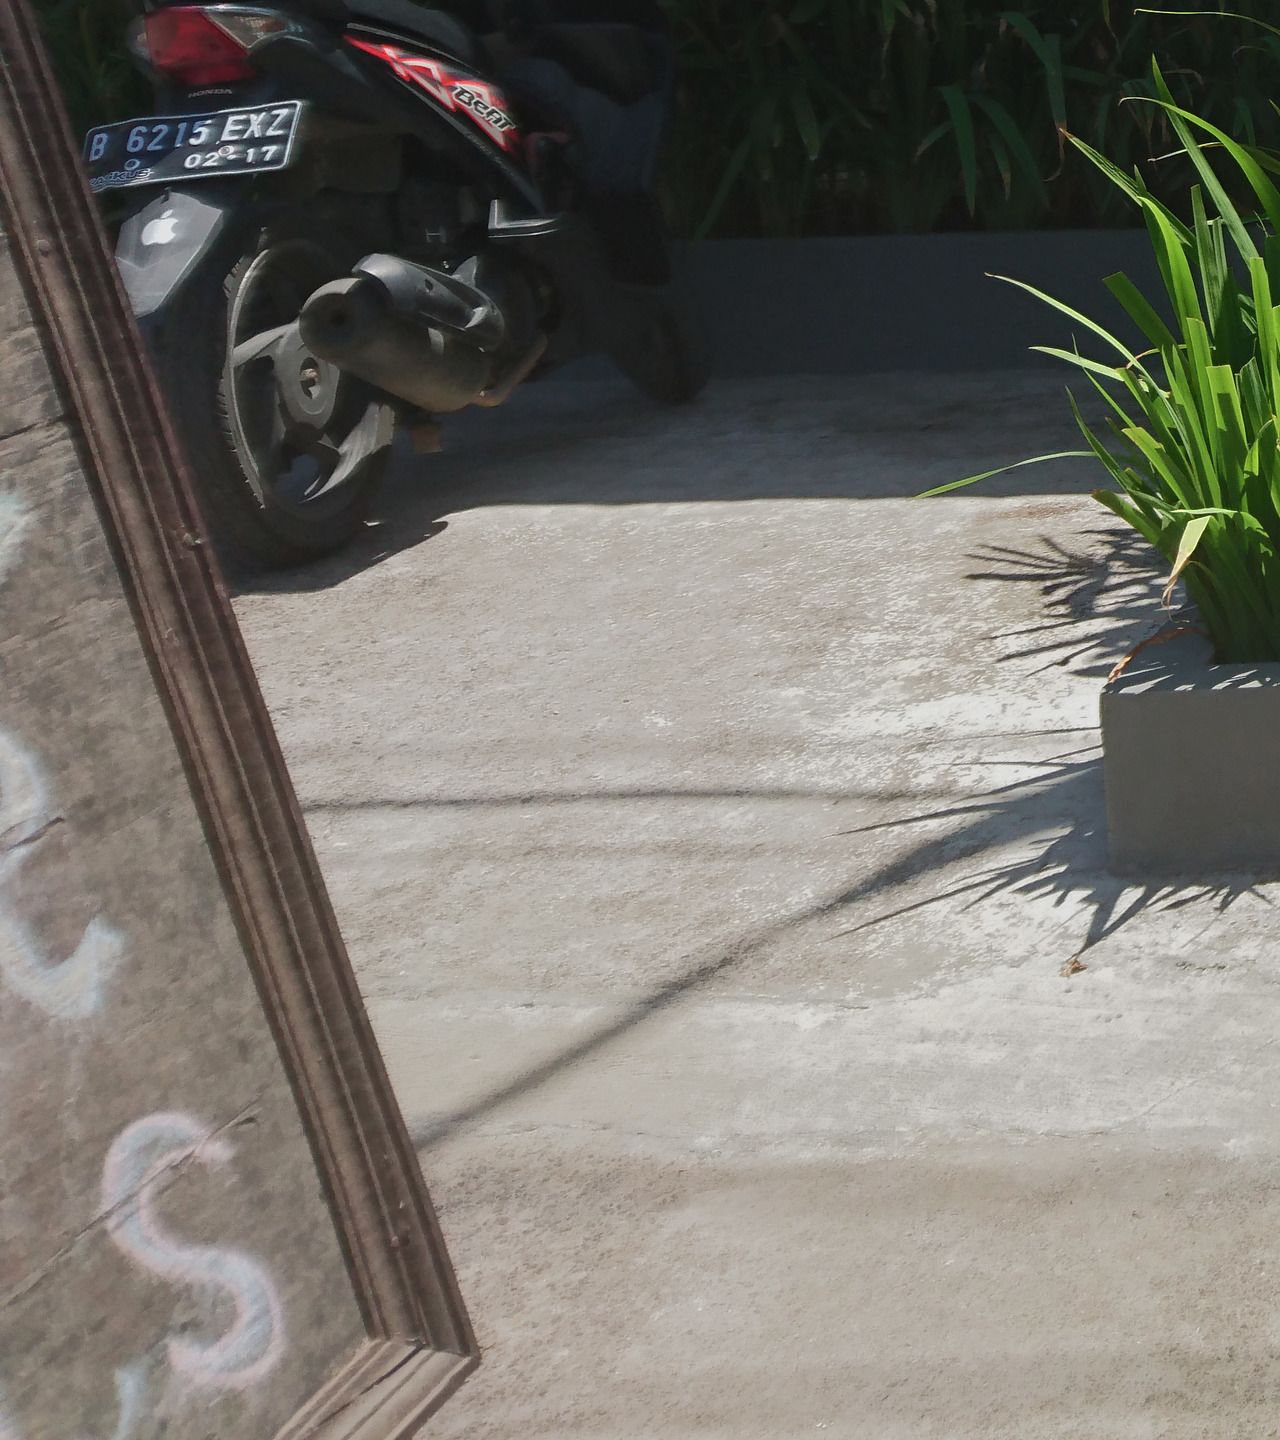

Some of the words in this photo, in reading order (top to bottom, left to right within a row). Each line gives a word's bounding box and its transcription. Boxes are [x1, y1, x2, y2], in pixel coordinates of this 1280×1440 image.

[187, 88, 233, 99] HONDA
[89, 132, 109, 161] B
[125, 119, 213, 154] 6215
[219, 108, 290, 143] EXZ
